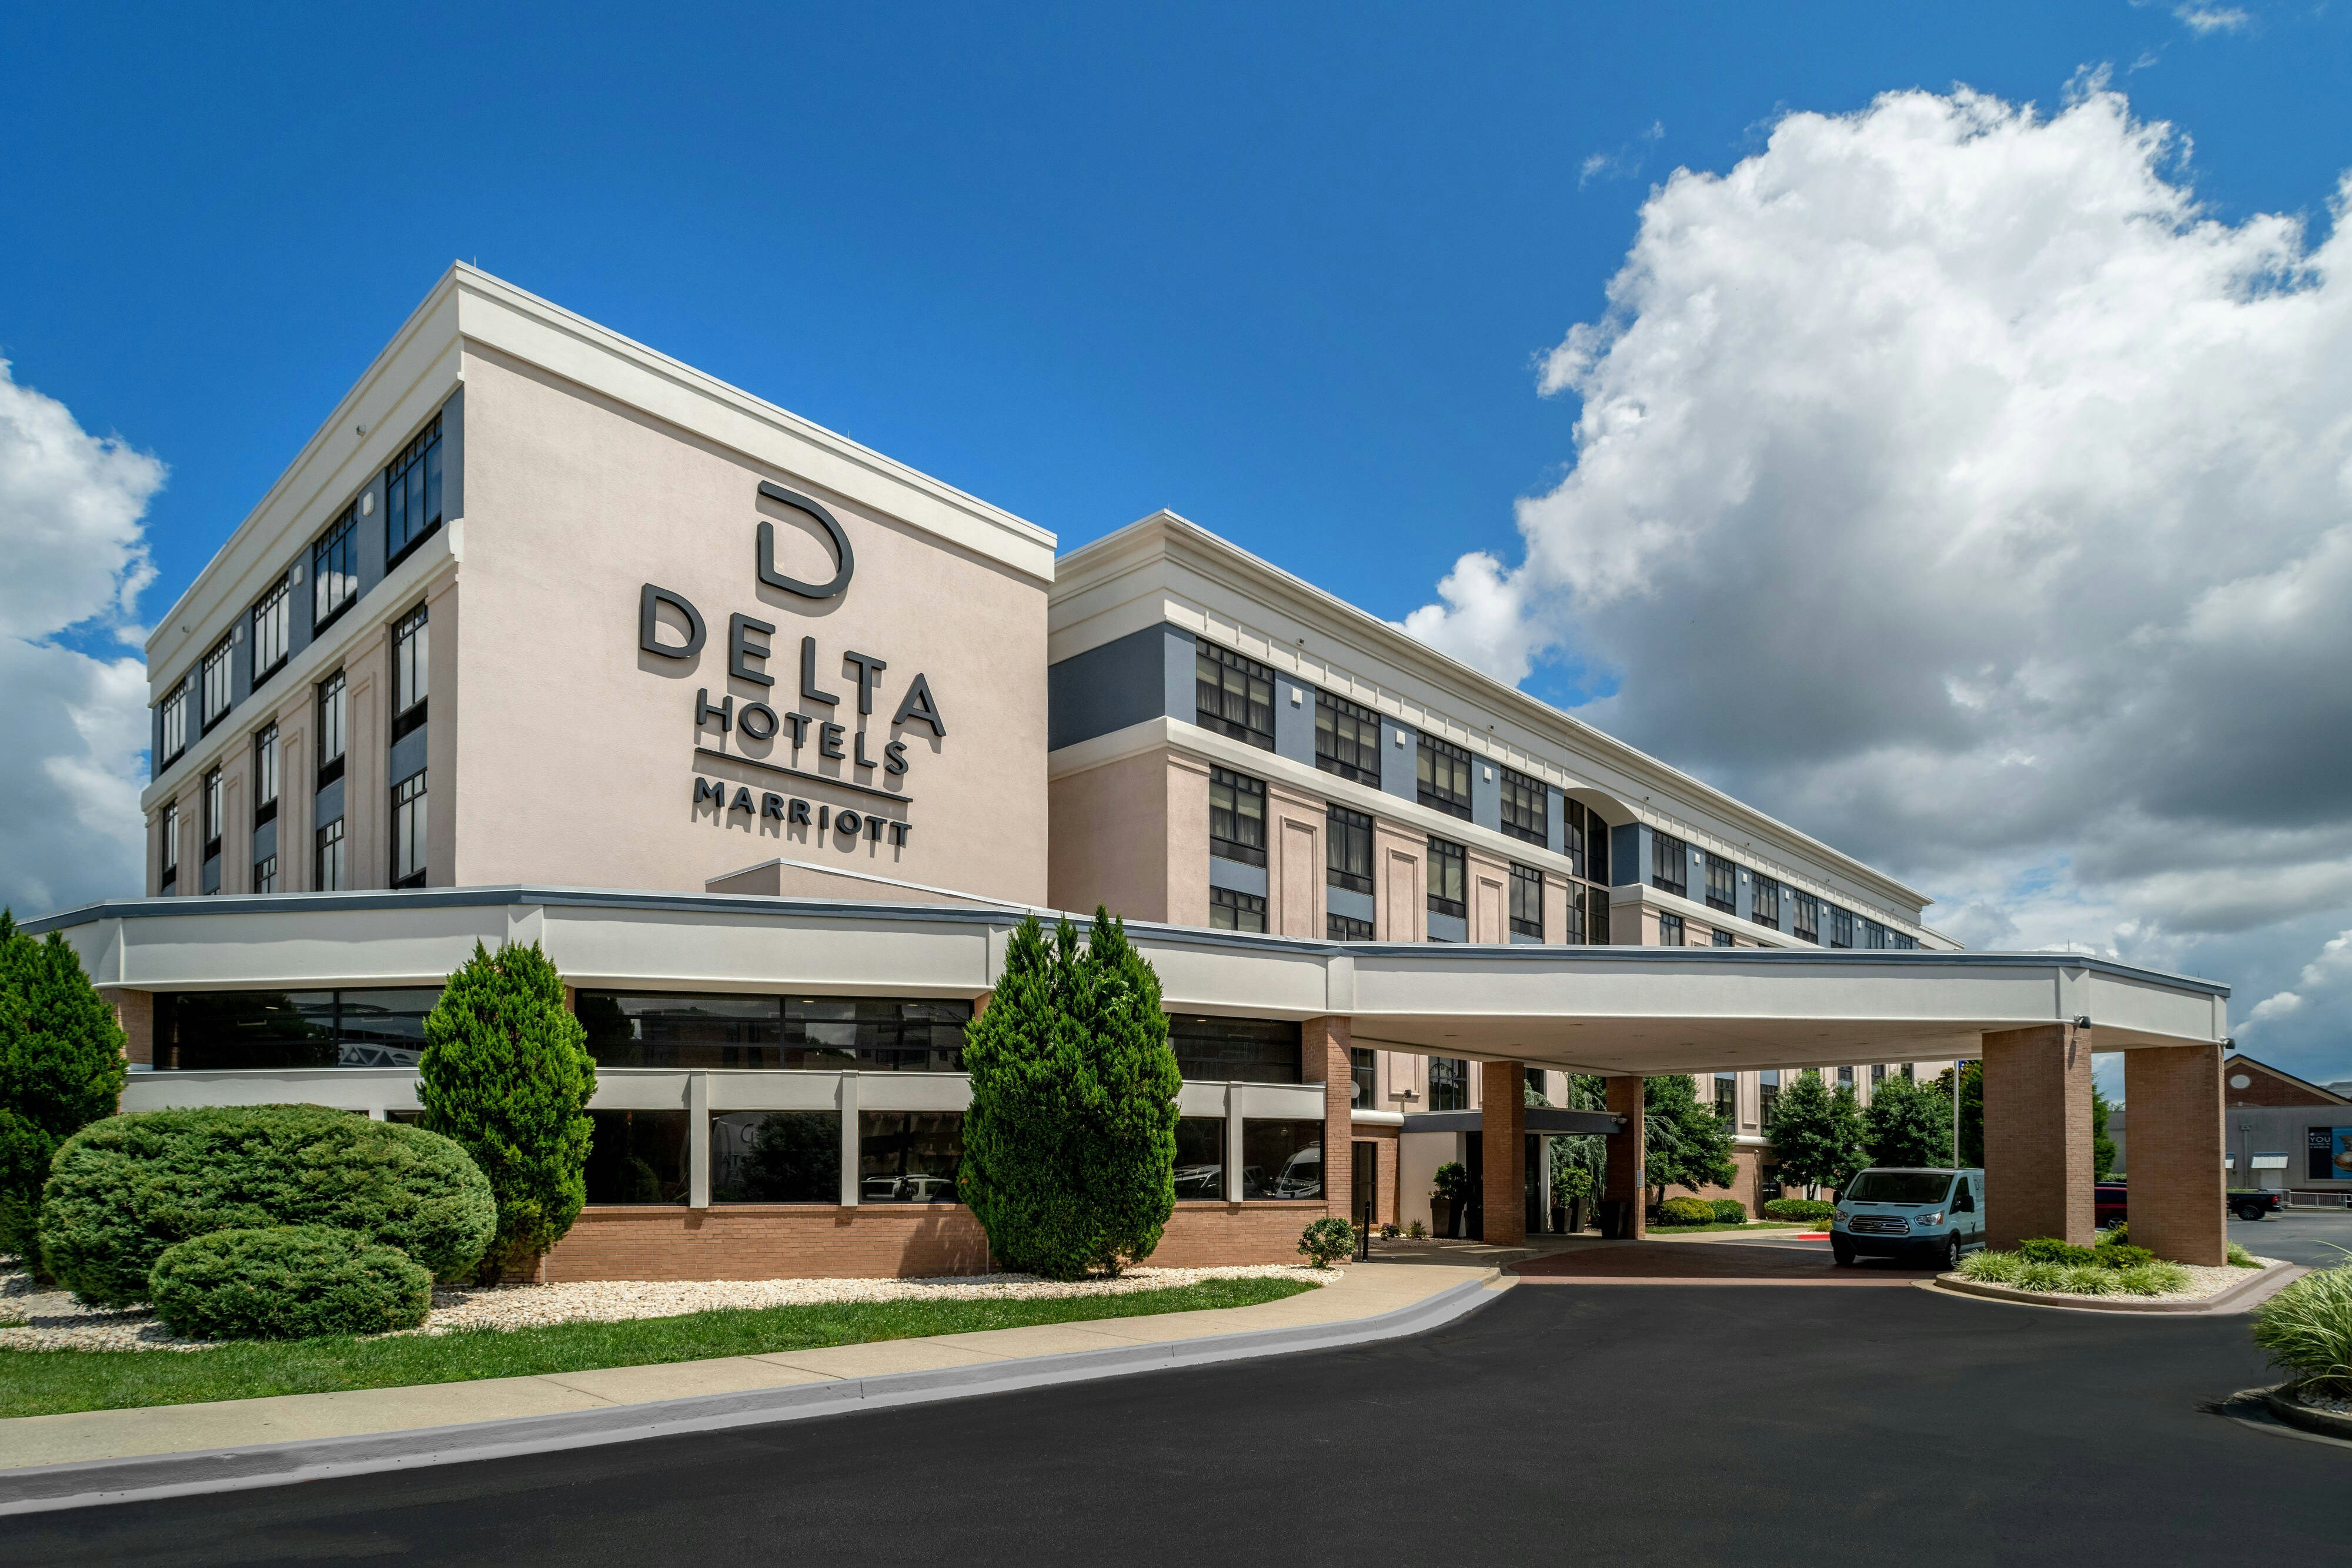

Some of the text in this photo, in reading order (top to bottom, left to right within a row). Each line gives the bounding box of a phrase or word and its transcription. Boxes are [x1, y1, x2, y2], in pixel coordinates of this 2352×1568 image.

[757, 480, 854, 599] D
[640, 583, 946, 737] DELTA
[696, 688, 908, 775] HOTELS
[694, 777, 912, 846] MARRIOTT
